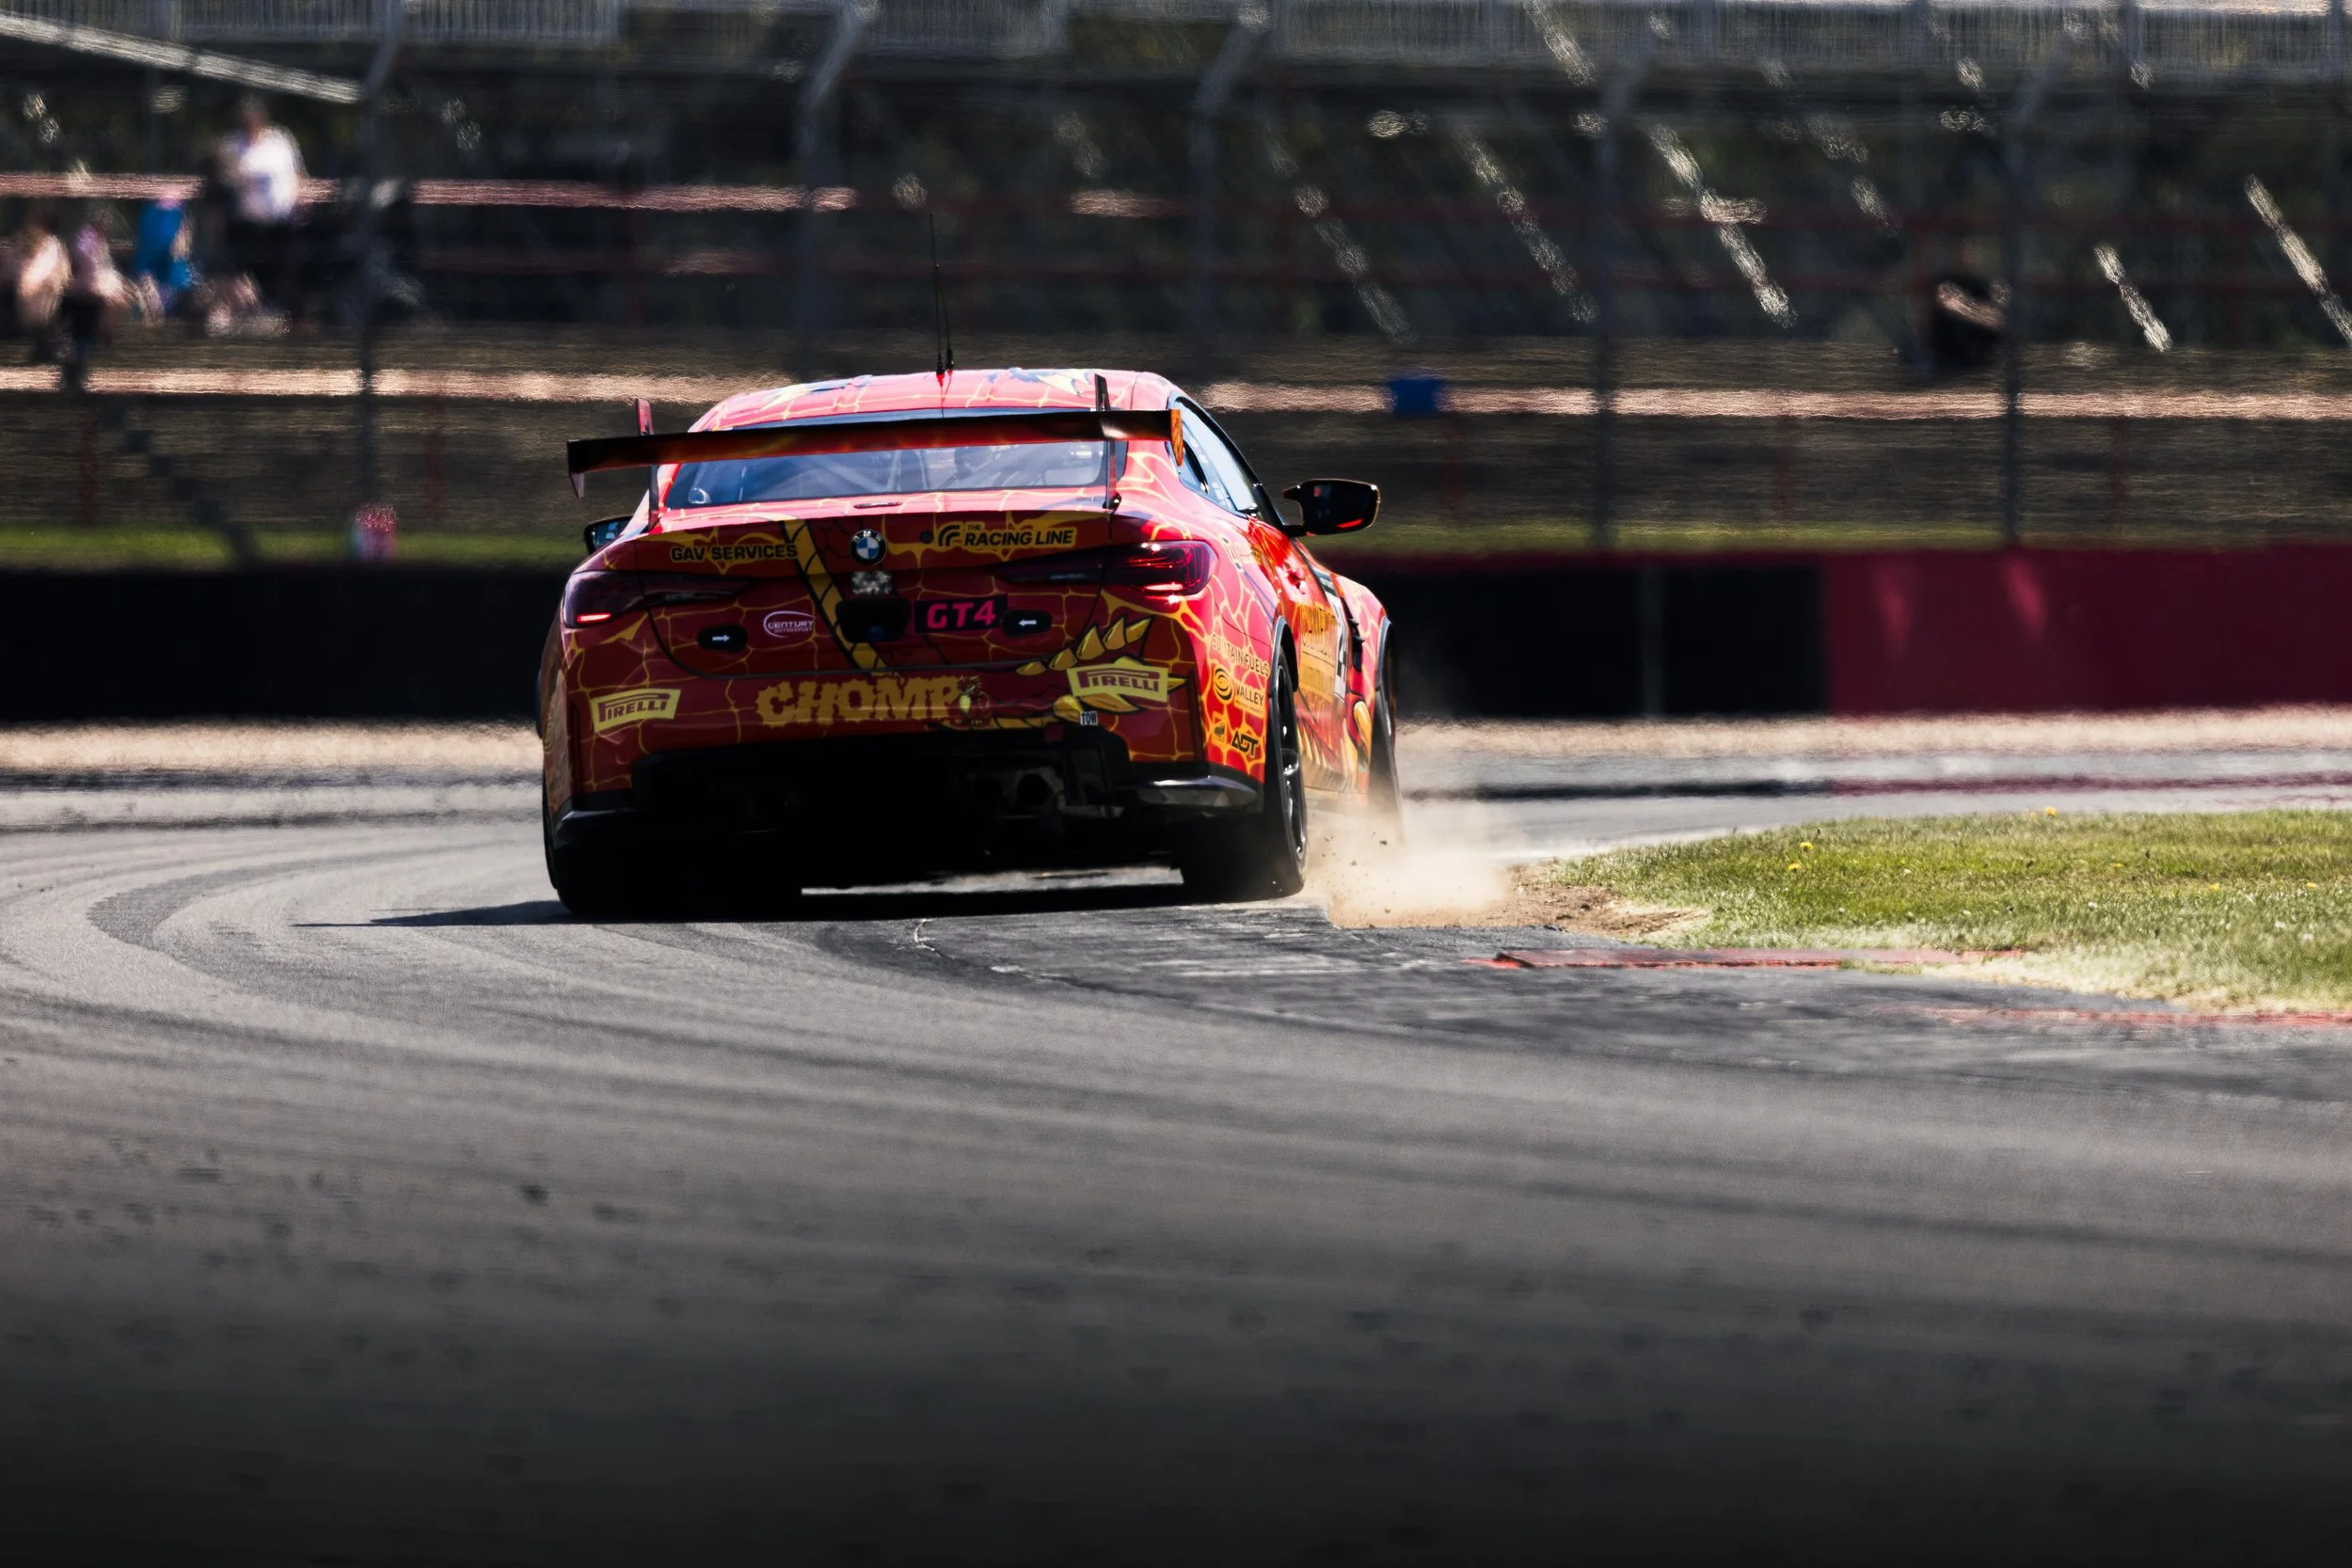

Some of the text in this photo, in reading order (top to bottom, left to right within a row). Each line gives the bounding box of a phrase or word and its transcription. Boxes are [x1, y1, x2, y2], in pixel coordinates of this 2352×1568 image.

[964, 530, 1073, 546] RACING LINE
[672, 544, 798, 561] GAV SERVICES
[768, 620, 814, 628] CENTURY
[927, 600, 996, 629] GT4
[1245, 653, 1269, 676] FUELS
[1077, 668, 1160, 691] PIRELLI
[755, 675, 961, 729] CHOMP
[1235, 682, 1264, 706] VALLEY
[597, 693, 671, 722] PIRELLI
[1081, 712, 1097, 724] TOW
